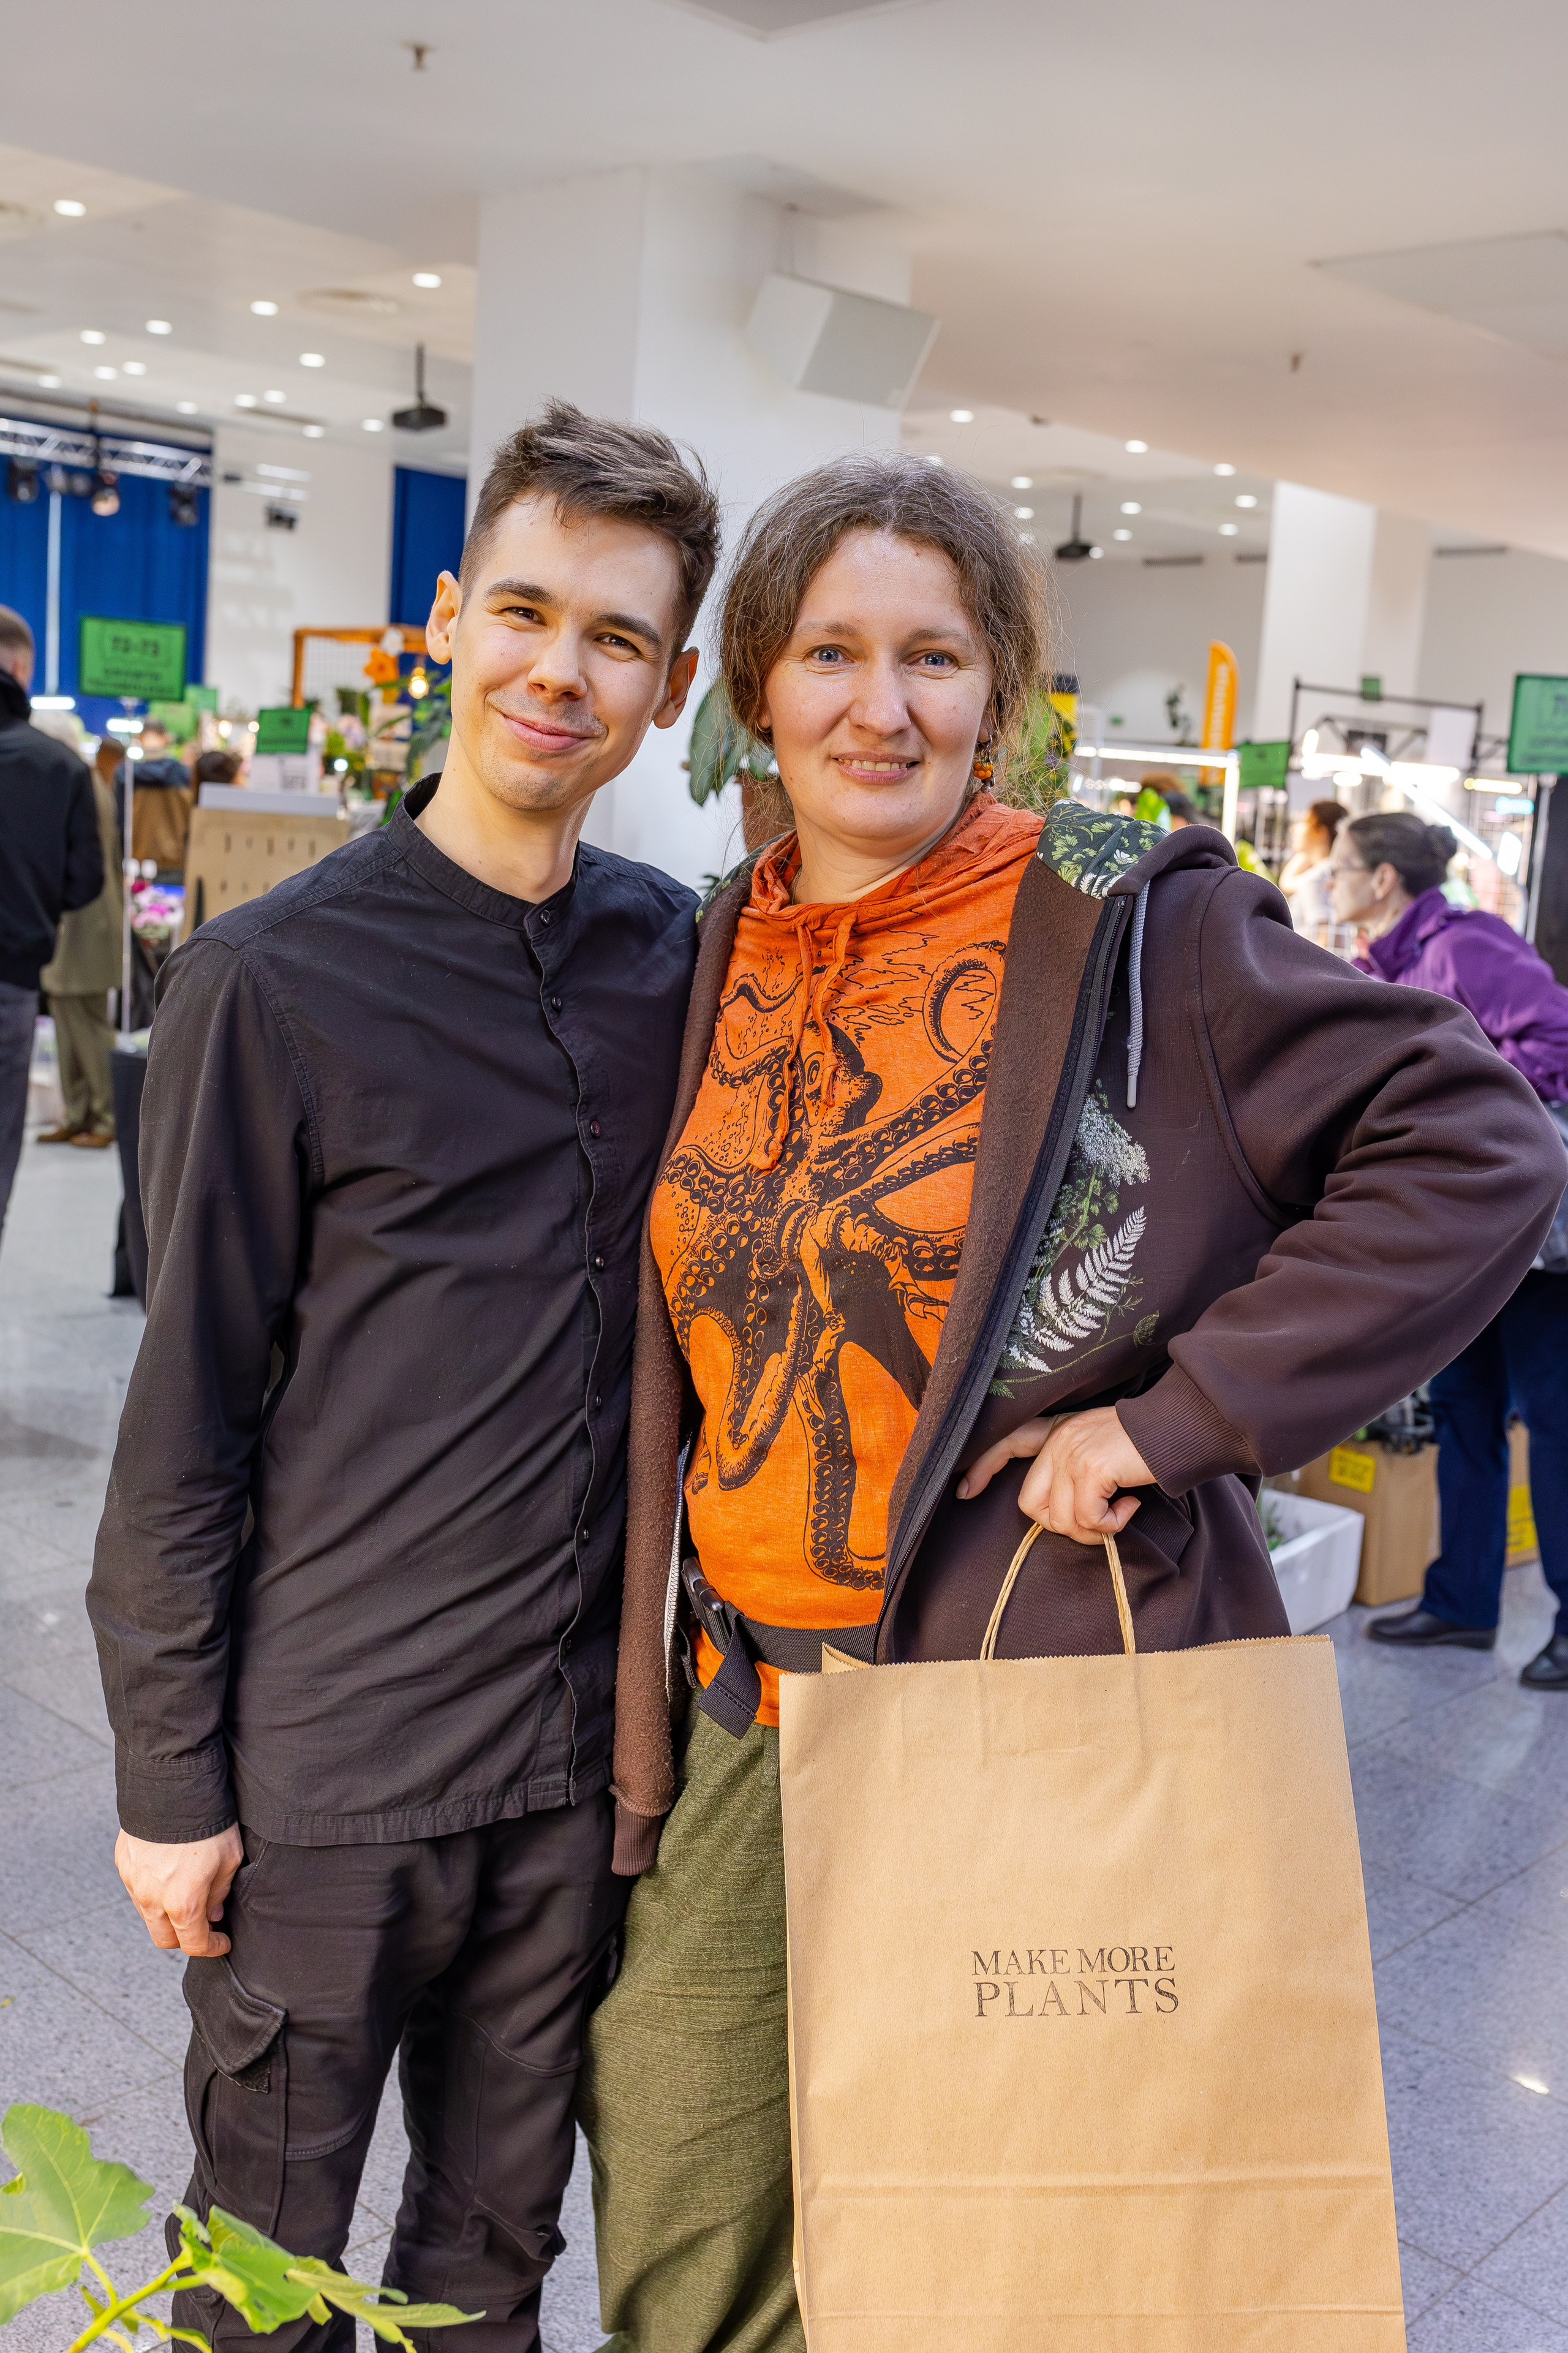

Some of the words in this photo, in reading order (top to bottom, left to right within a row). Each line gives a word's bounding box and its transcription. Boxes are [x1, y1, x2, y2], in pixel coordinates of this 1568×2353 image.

[971, 1949, 1071, 1976] MAKE
[1076, 1946, 1176, 1974] MORE
[972, 1977, 1179, 2017] PLANTS
